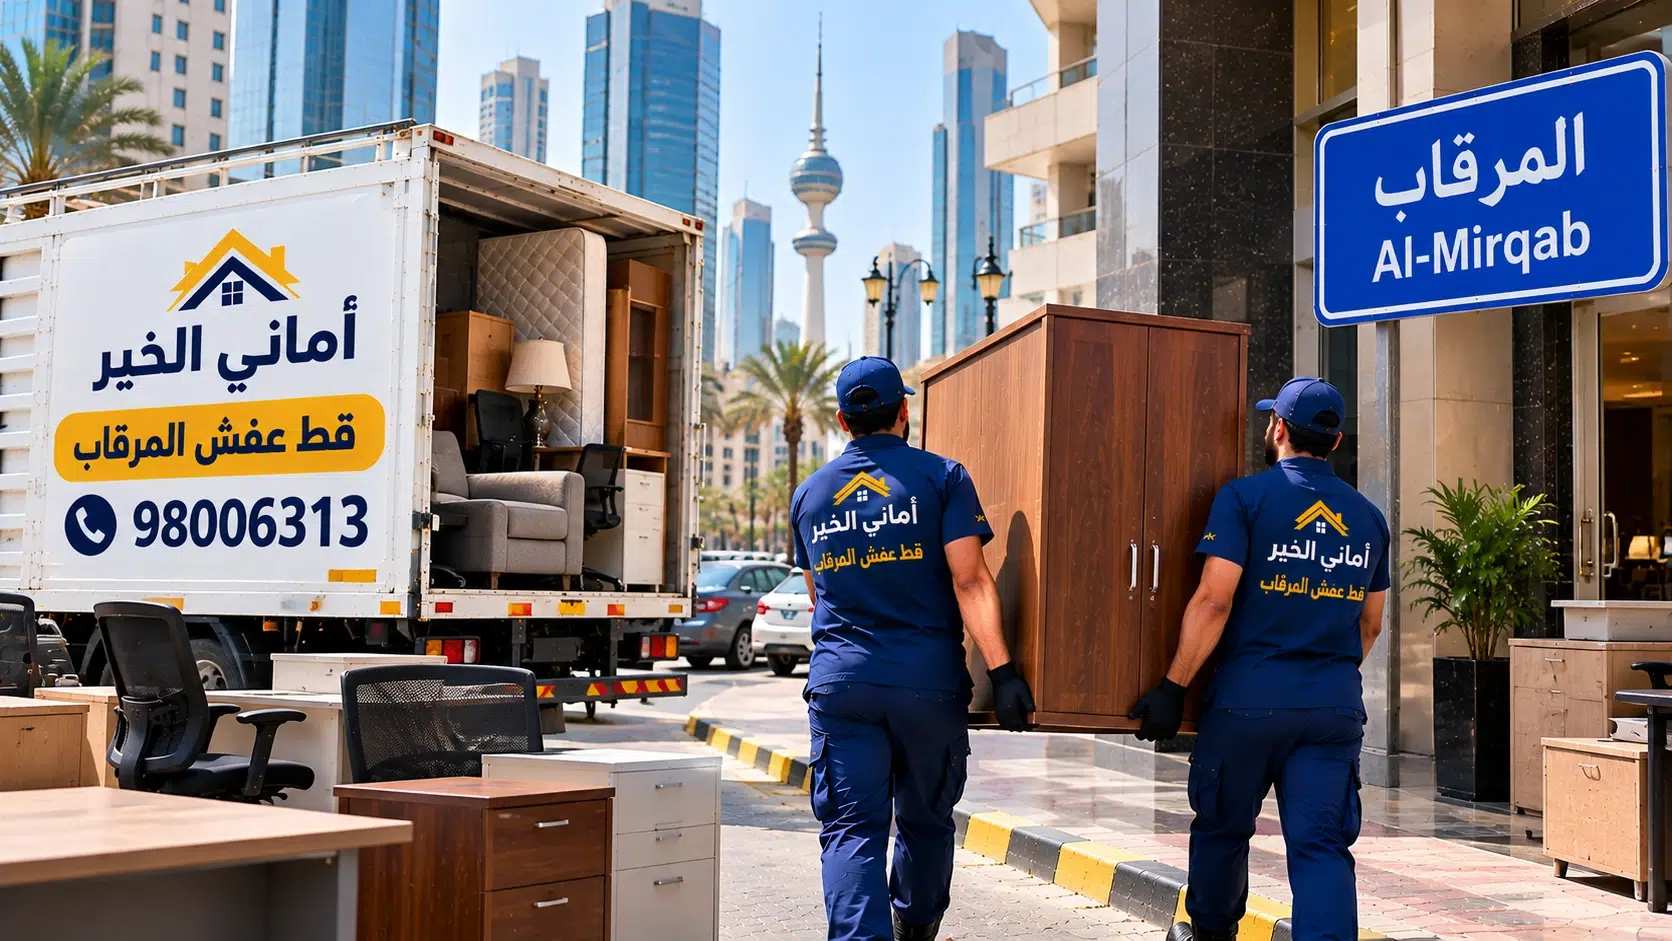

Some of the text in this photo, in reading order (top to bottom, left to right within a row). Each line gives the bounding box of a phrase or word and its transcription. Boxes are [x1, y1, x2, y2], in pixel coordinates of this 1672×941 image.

[1374, 111, 1585, 223] المرقاب
[1372, 210, 1591, 283] Al-Mirqab
[92, 294, 358, 394] أماني الخير
[73, 412, 356, 471] قط عفش المرقاب
[133, 494, 369, 548] 98006313
[811, 496, 918, 544] أماني الخير
[813, 542, 924, 576] قط عفش المرقاب
[1267, 539, 1371, 573] أماني الخير
[1346, 584, 1365, 601] قط
